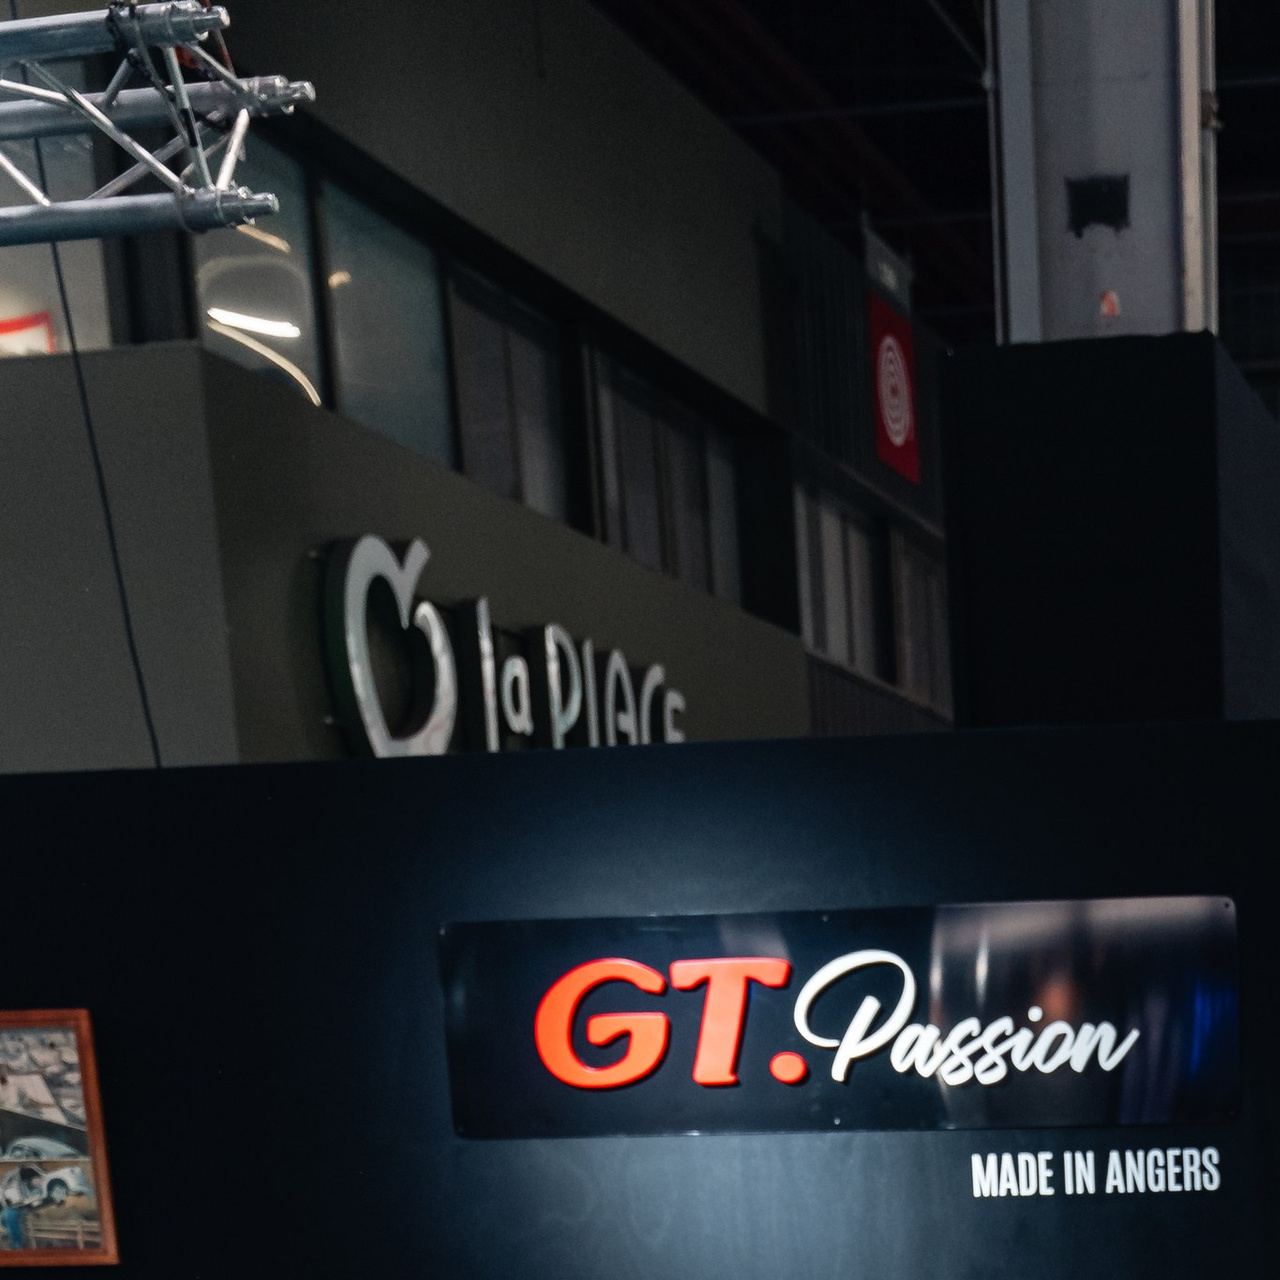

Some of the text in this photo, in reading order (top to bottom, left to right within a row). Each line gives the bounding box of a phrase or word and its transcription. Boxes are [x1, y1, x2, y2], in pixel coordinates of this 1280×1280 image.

[793, 949, 1140, 1086] Passion
[970, 1146, 1221, 1199] MADE IN ANGERS
